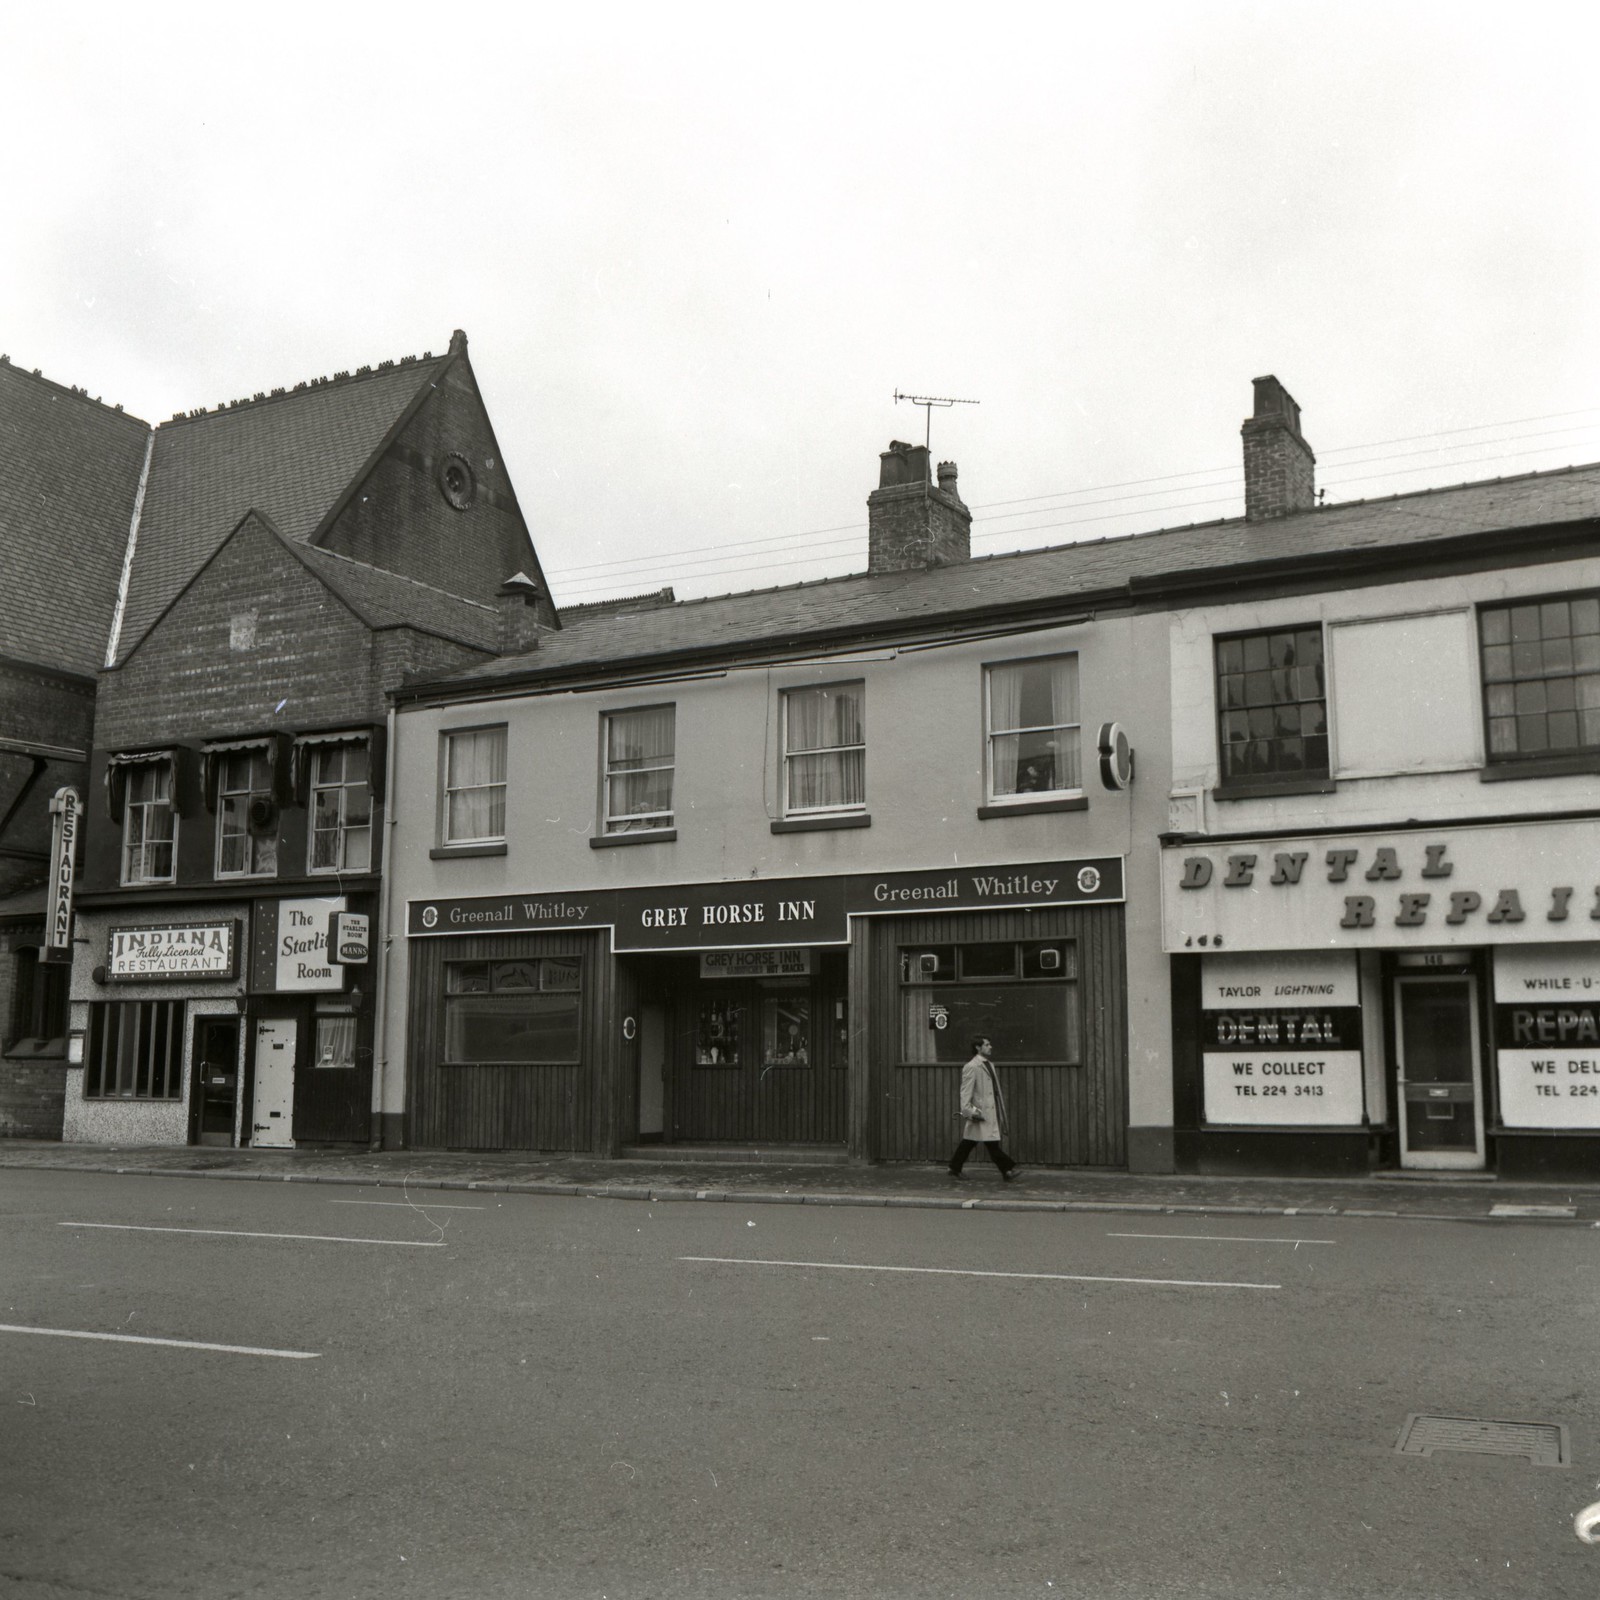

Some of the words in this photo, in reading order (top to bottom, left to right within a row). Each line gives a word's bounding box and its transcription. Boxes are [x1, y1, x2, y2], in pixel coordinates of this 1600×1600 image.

[56, 794, 76, 946] RESTAURANT
[1179, 845, 1454, 889] DENTAL
[874, 879, 959, 902] Greenall
[972, 875, 1059, 896] Whitley
[289, 910, 314, 927] The
[450, 905, 514, 924] Greenall
[523, 902, 589, 920] Whitley
[641, 907, 689, 928] GREY
[702, 903, 765, 925] HORSE
[778, 900, 816, 921] INN
[115, 930, 225, 959] INDIANA
[281, 931, 329, 957] Starlit
[342, 946, 368, 956] MANNS
[135, 945, 163, 963] Fully
[163, 944, 206, 958] Licensed
[705, 954, 735, 967] GREY
[736, 952, 775, 966] HORSE
[779, 950, 801, 964] INN
[1424, 954, 1443, 966] 146
[118, 957, 222, 972] RESTAURANT
[297, 962, 332, 979] Room
[1218, 986, 1262, 998] TAYLOR
[1274, 984, 1335, 996] LIGHTNING
[1217, 1014, 1341, 1044] DENTAL
[1512, 1010, 1600, 1043] REPA
[1232, 1062, 1253, 1075] WE
[1262, 1062, 1326, 1076] COLLECT
[1531, 1061, 1557, 1075] WE
[1234, 1085, 1258, 1096] TEL
[1262, 1085, 1287, 1096] 224
[1294, 1085, 1324, 1096] 3413
[1536, 1085, 1561, 1096] TEL
[1570, 1085, 1599, 1096] 224
